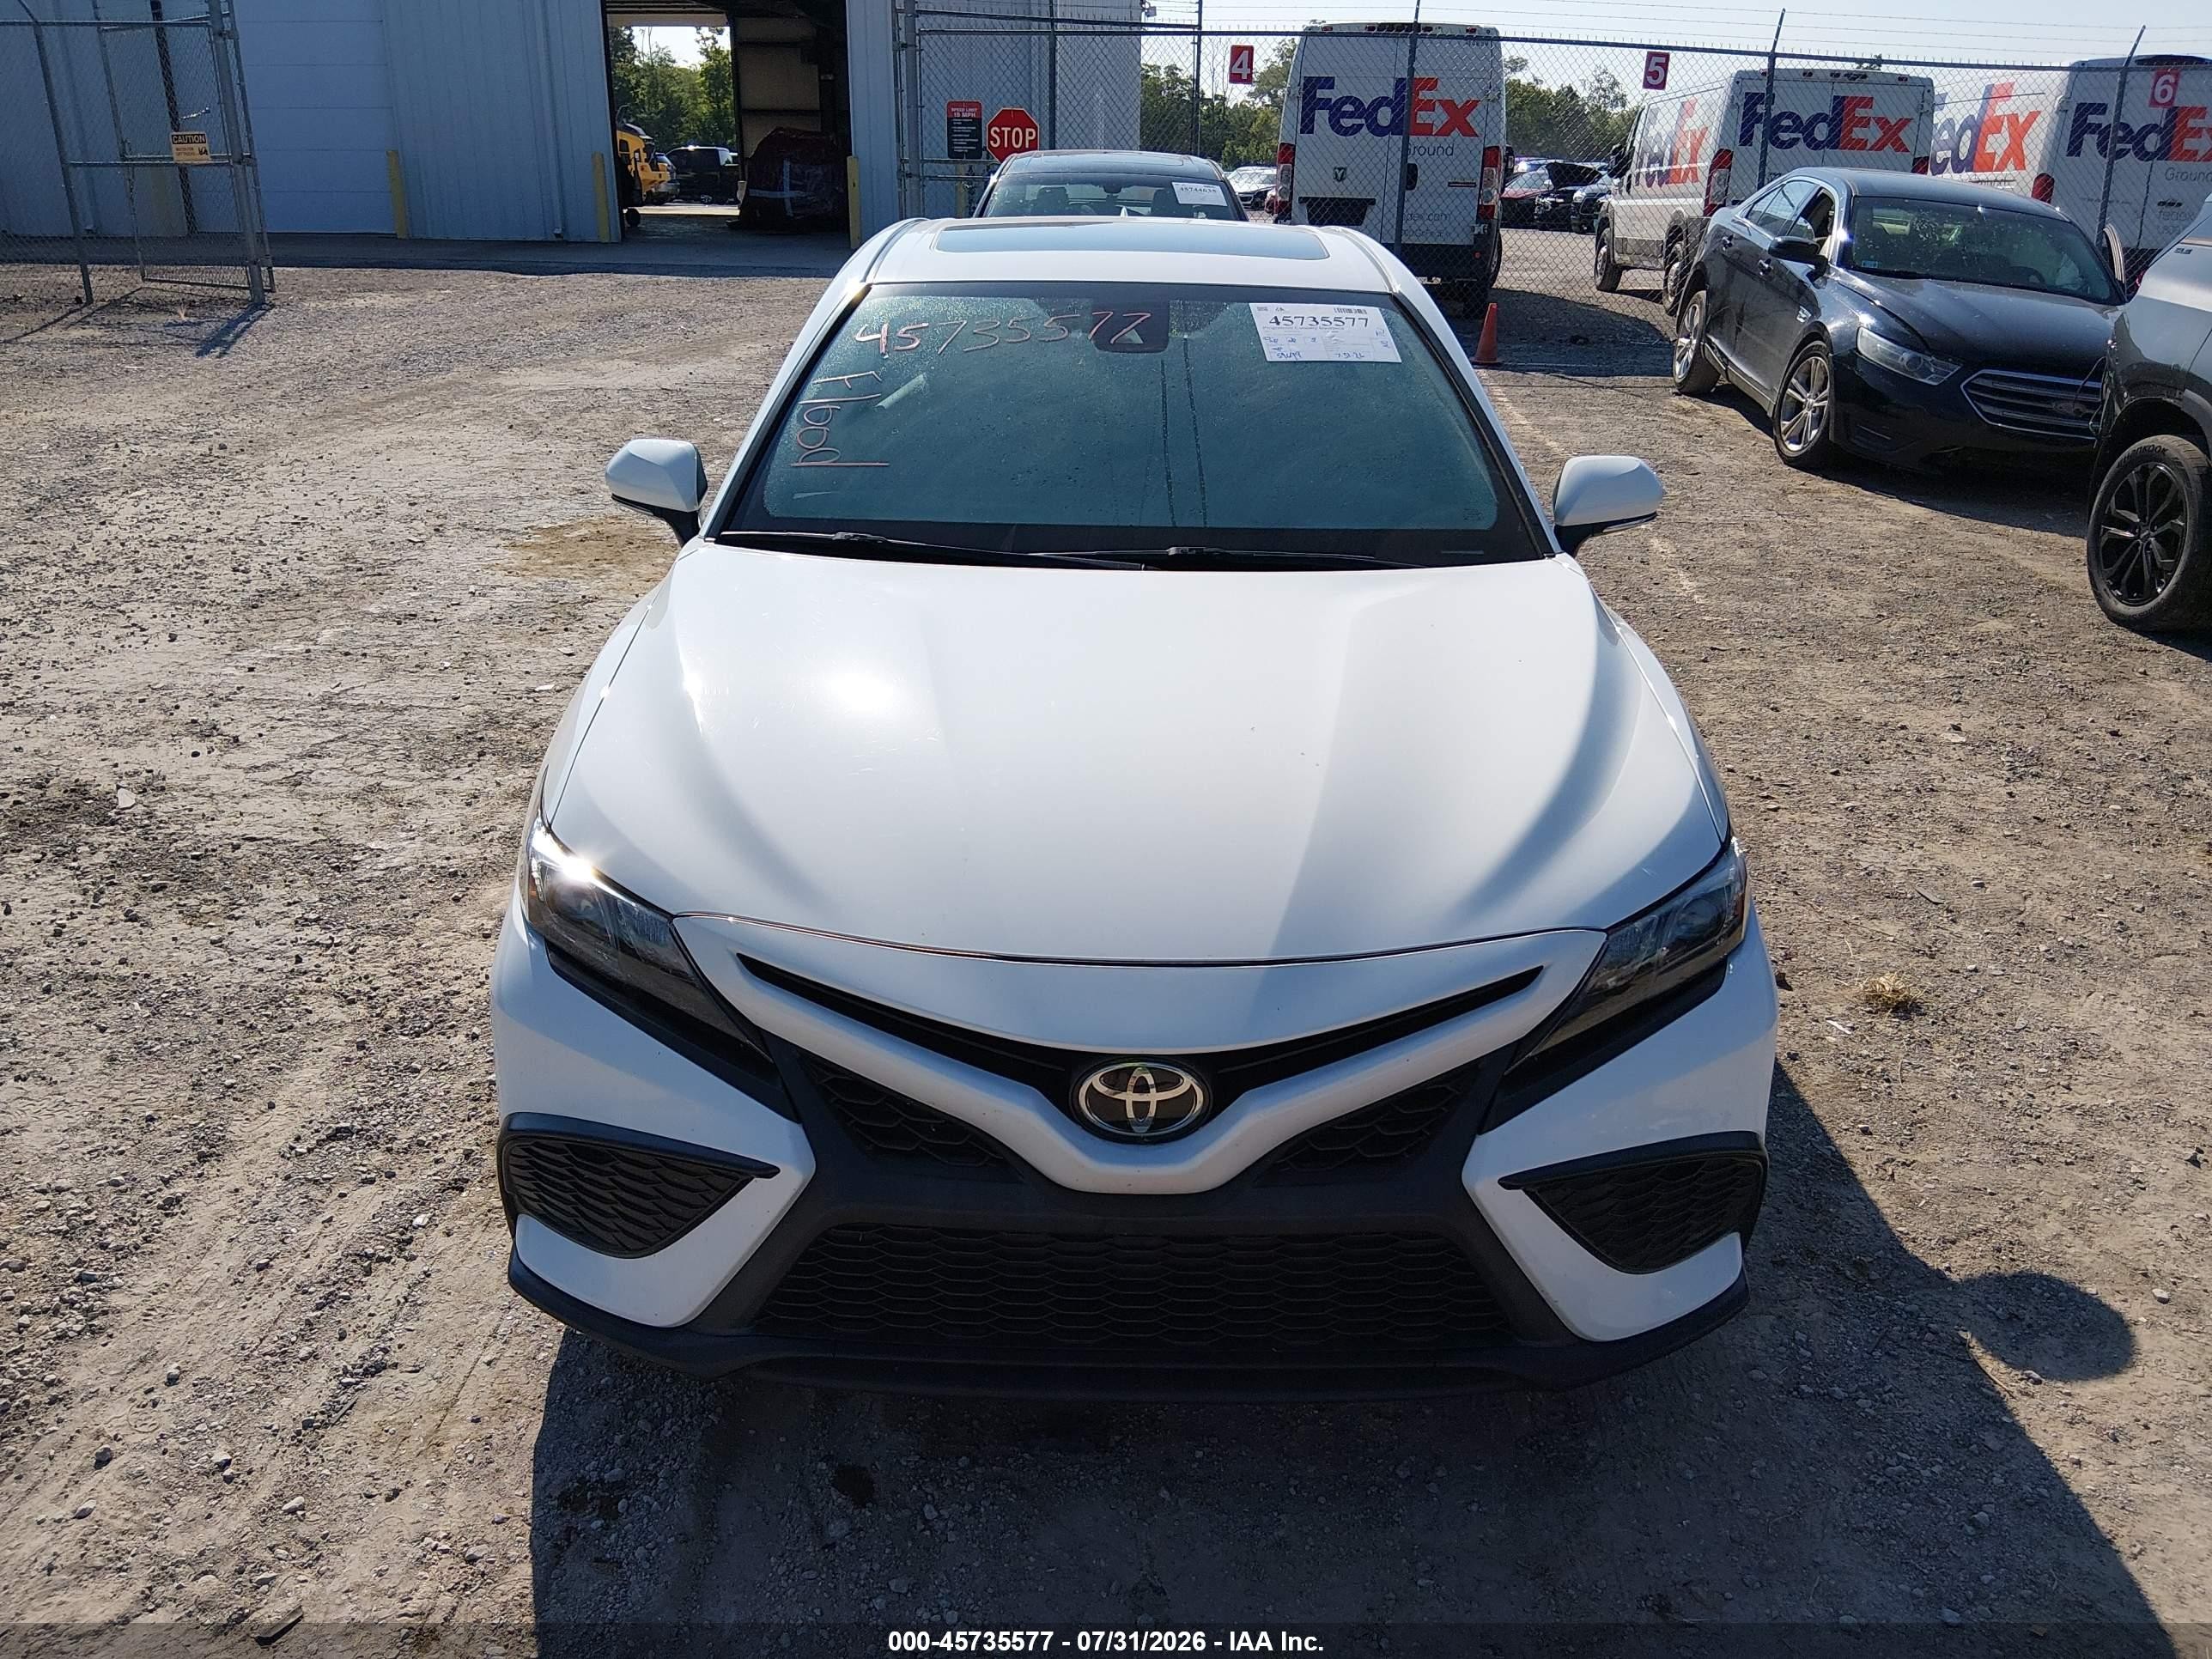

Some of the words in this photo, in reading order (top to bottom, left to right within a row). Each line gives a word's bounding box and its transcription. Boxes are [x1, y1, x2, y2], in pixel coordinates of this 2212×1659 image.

[1231, 50, 1250, 80] 4
[1647, 57, 1666, 85] 5
[2154, 75, 2174, 104] 6
[1299, 76, 1481, 137] FedEx
[1739, 92, 1913, 153] FedEx
[173, 134, 206, 144] CAUTION
[989, 126, 1036, 149] STOP
[854, 311, 1152, 355] 45735577
[1269, 315, 1368, 327] 45735577
[790, 370, 890, 468] Flood
